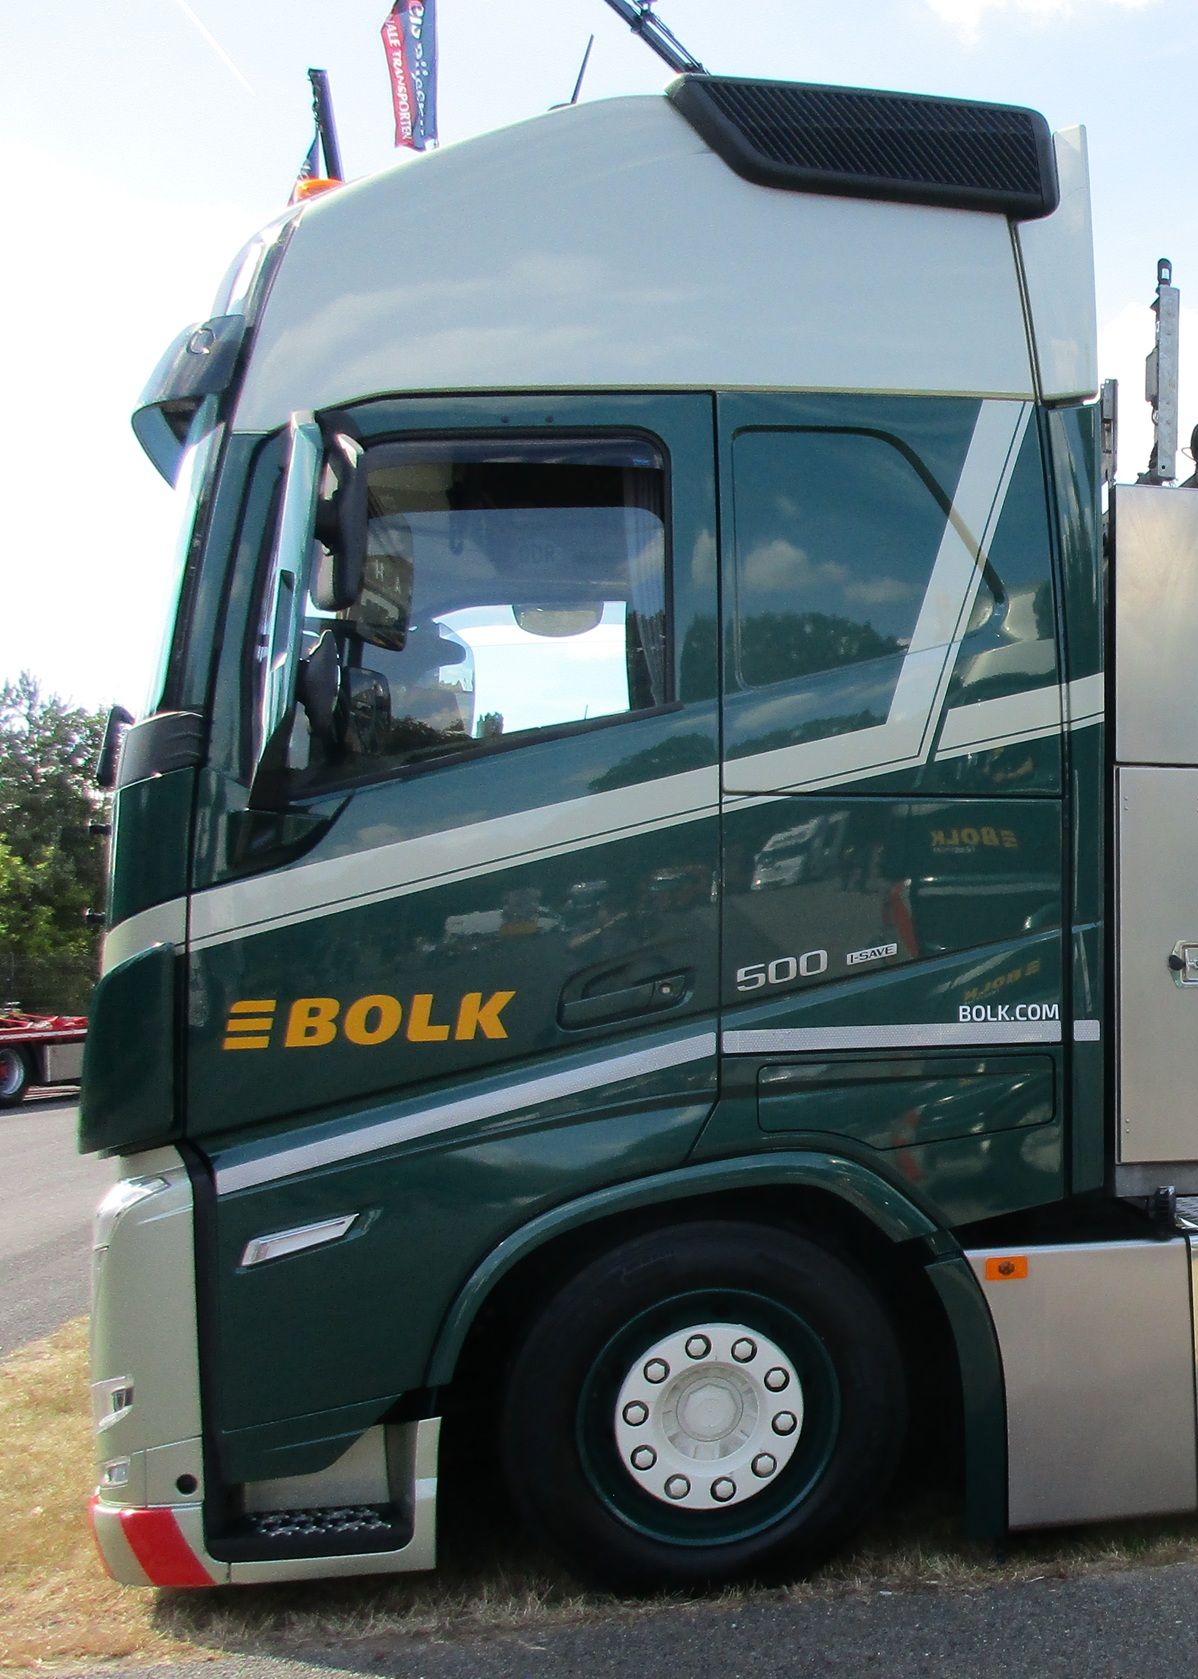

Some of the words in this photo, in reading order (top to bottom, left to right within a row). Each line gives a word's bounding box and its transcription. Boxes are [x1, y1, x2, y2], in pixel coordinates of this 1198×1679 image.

[391, 49, 413, 140] TRANSPORTEN
[737, 950, 828, 992] 500
[850, 945, 895, 963] I-SAVE
[284, 991, 516, 1047] BOLK
[959, 1004, 1060, 1022] BOLK.COM
